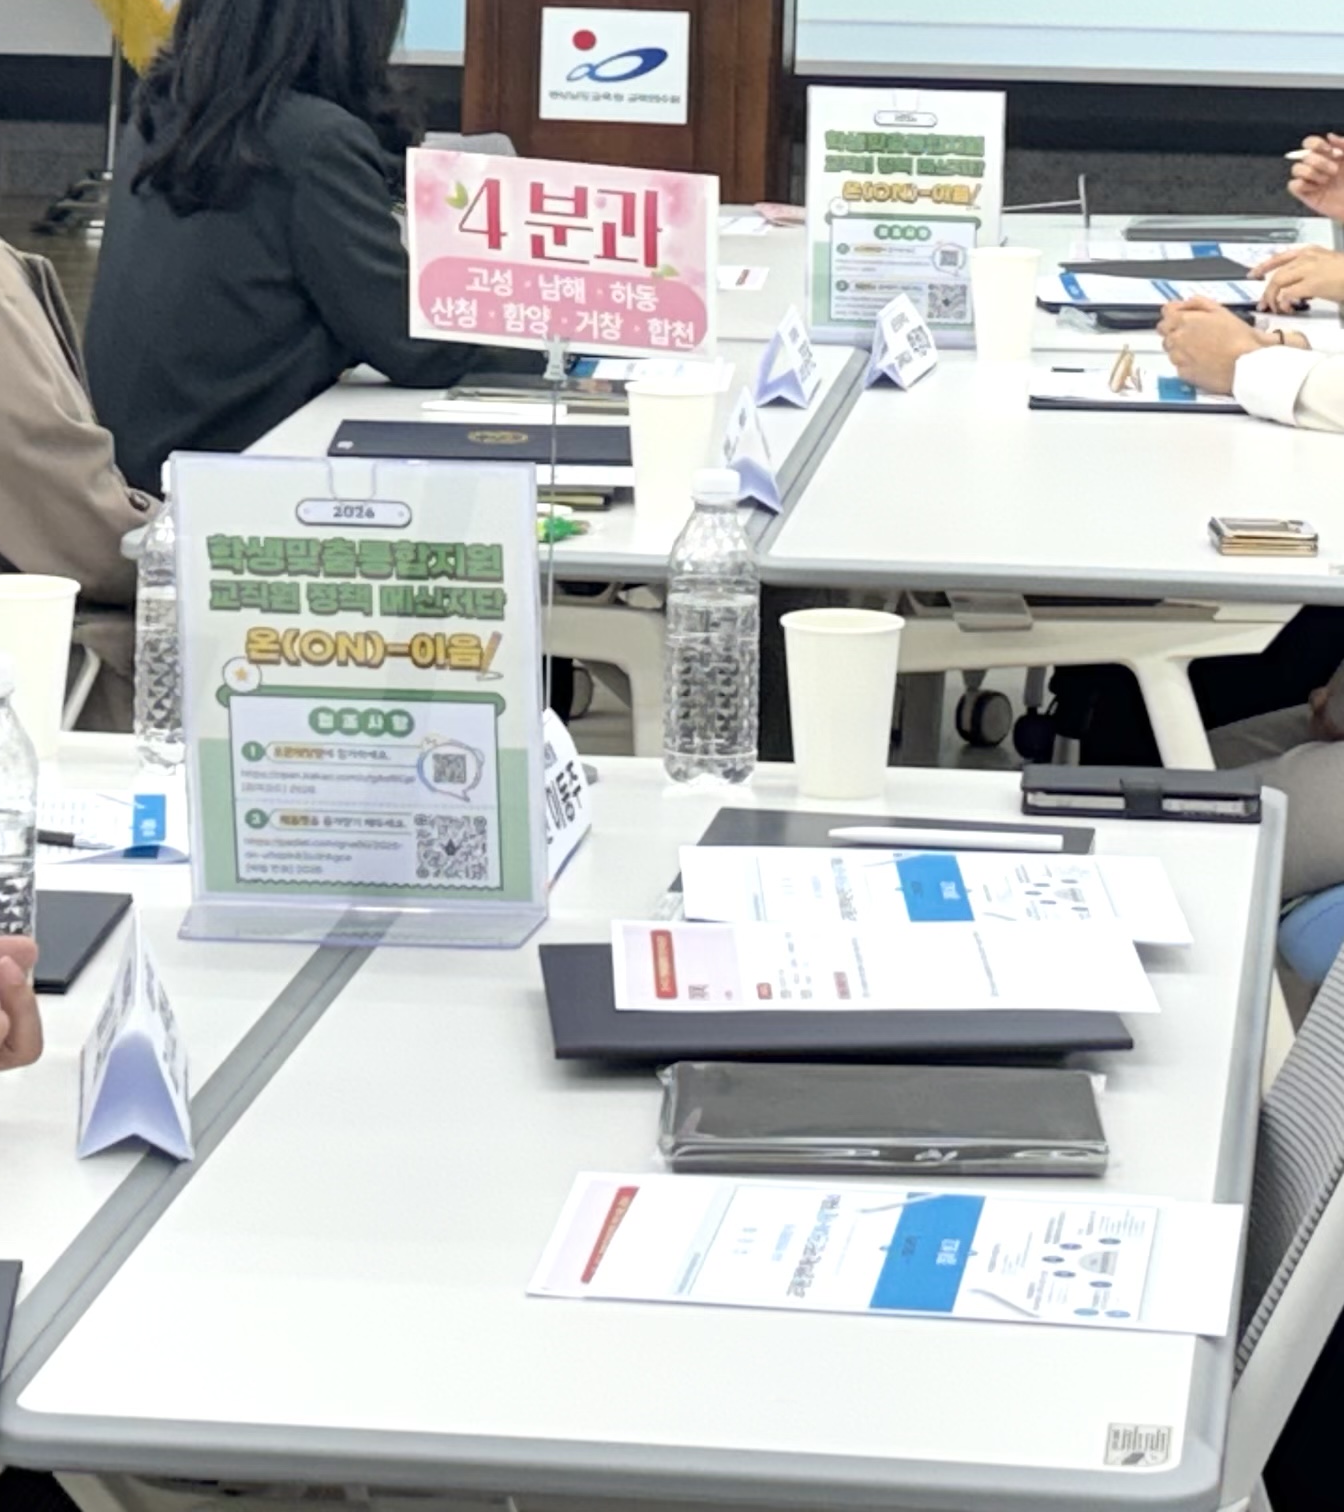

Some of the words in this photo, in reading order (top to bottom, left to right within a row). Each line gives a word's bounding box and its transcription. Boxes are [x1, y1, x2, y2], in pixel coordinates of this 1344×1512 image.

[465, 265, 514, 295] 고성
[537, 274, 587, 305] 남해
[610, 281, 660, 313] 하동
[430, 295, 479, 329] 산청
[502, 301, 552, 335] 함양
[575, 309, 624, 342] 거창
[647, 317, 696, 350] 합천
[332, 505, 377, 520] 2026
[206, 532, 505, 583] 학생맞춤통합지원
[208, 579, 302, 615] 교직원
[306, 581, 374, 617] 정책
[379, 584, 508, 622] 메신저단
